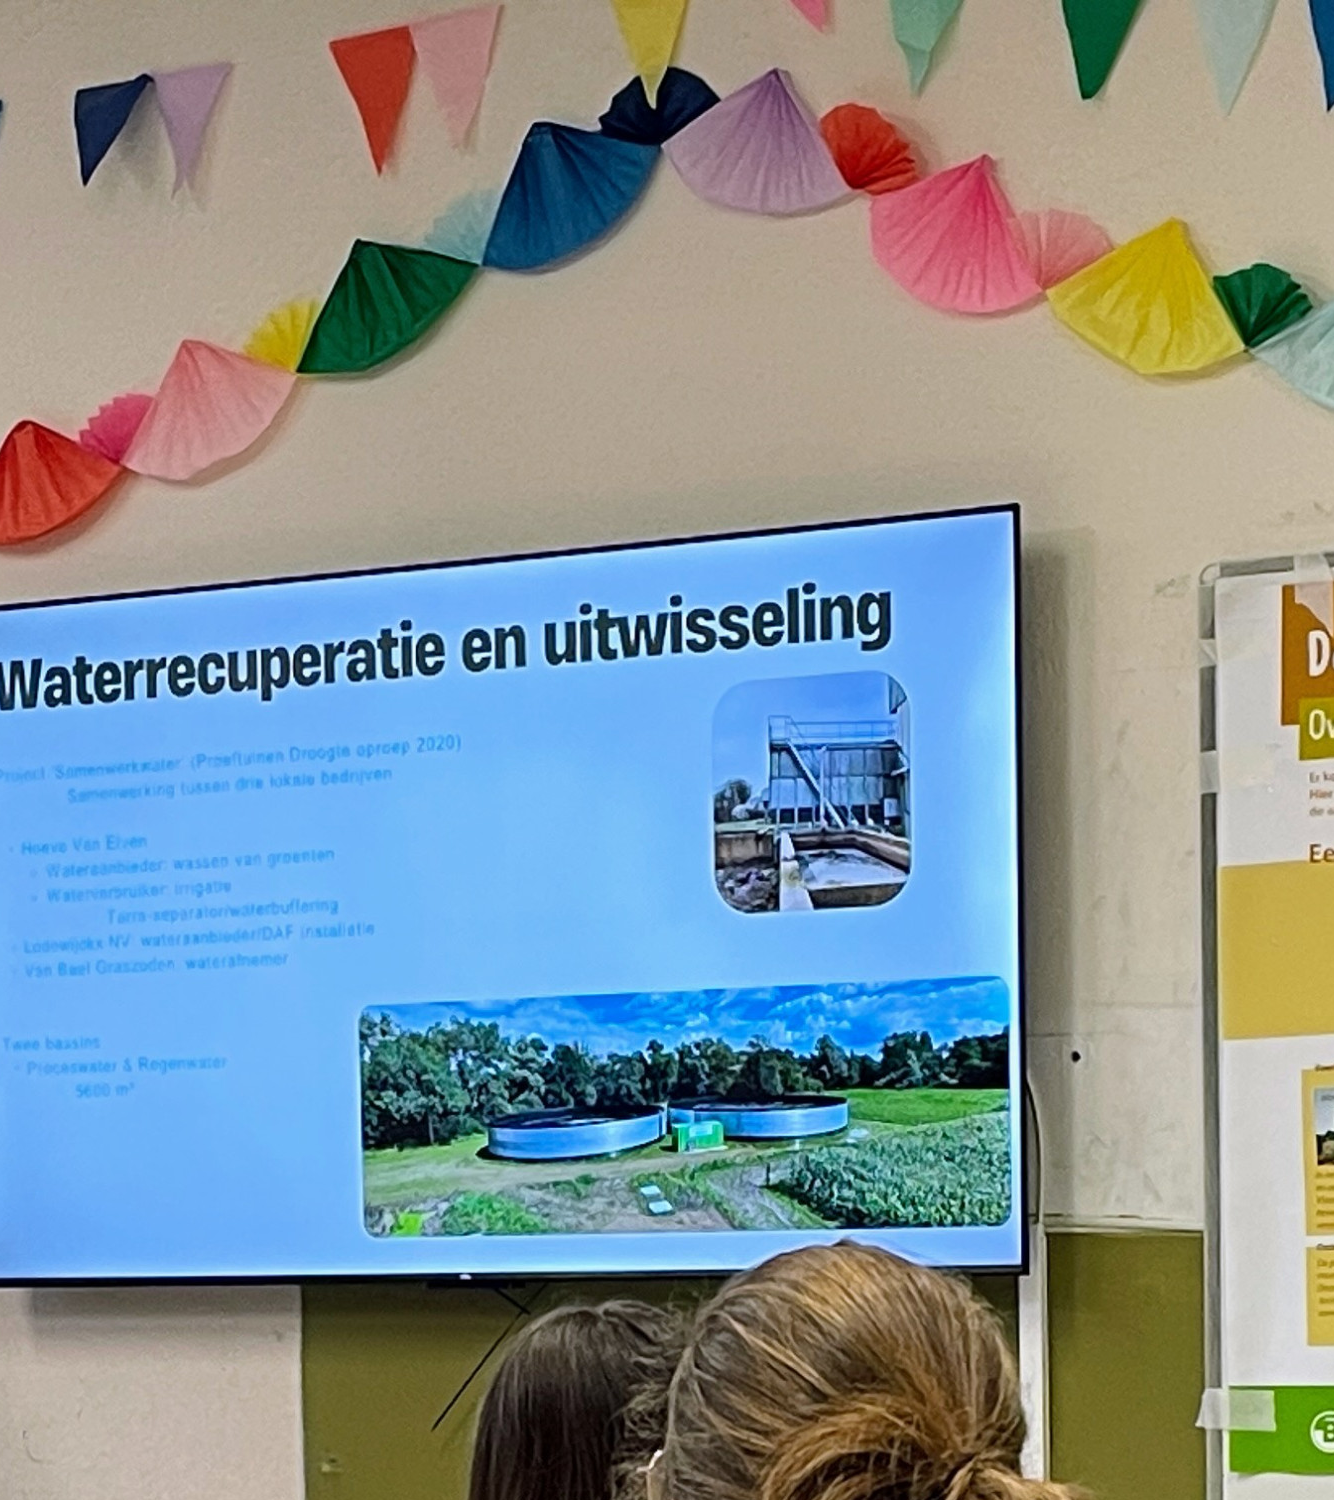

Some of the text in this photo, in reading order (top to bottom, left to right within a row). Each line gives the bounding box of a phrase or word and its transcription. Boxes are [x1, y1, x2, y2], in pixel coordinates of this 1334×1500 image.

[461, 622, 527, 674] en
[543, 582, 892, 667] uitwisseling
[355, 740, 411, 760] oproep
[415, 733, 462, 754] 2020)
[181, 779, 230, 797] tussen
[173, 856, 229, 871] wassen
[235, 853, 262, 868] van
[267, 847, 336, 869] groenten
